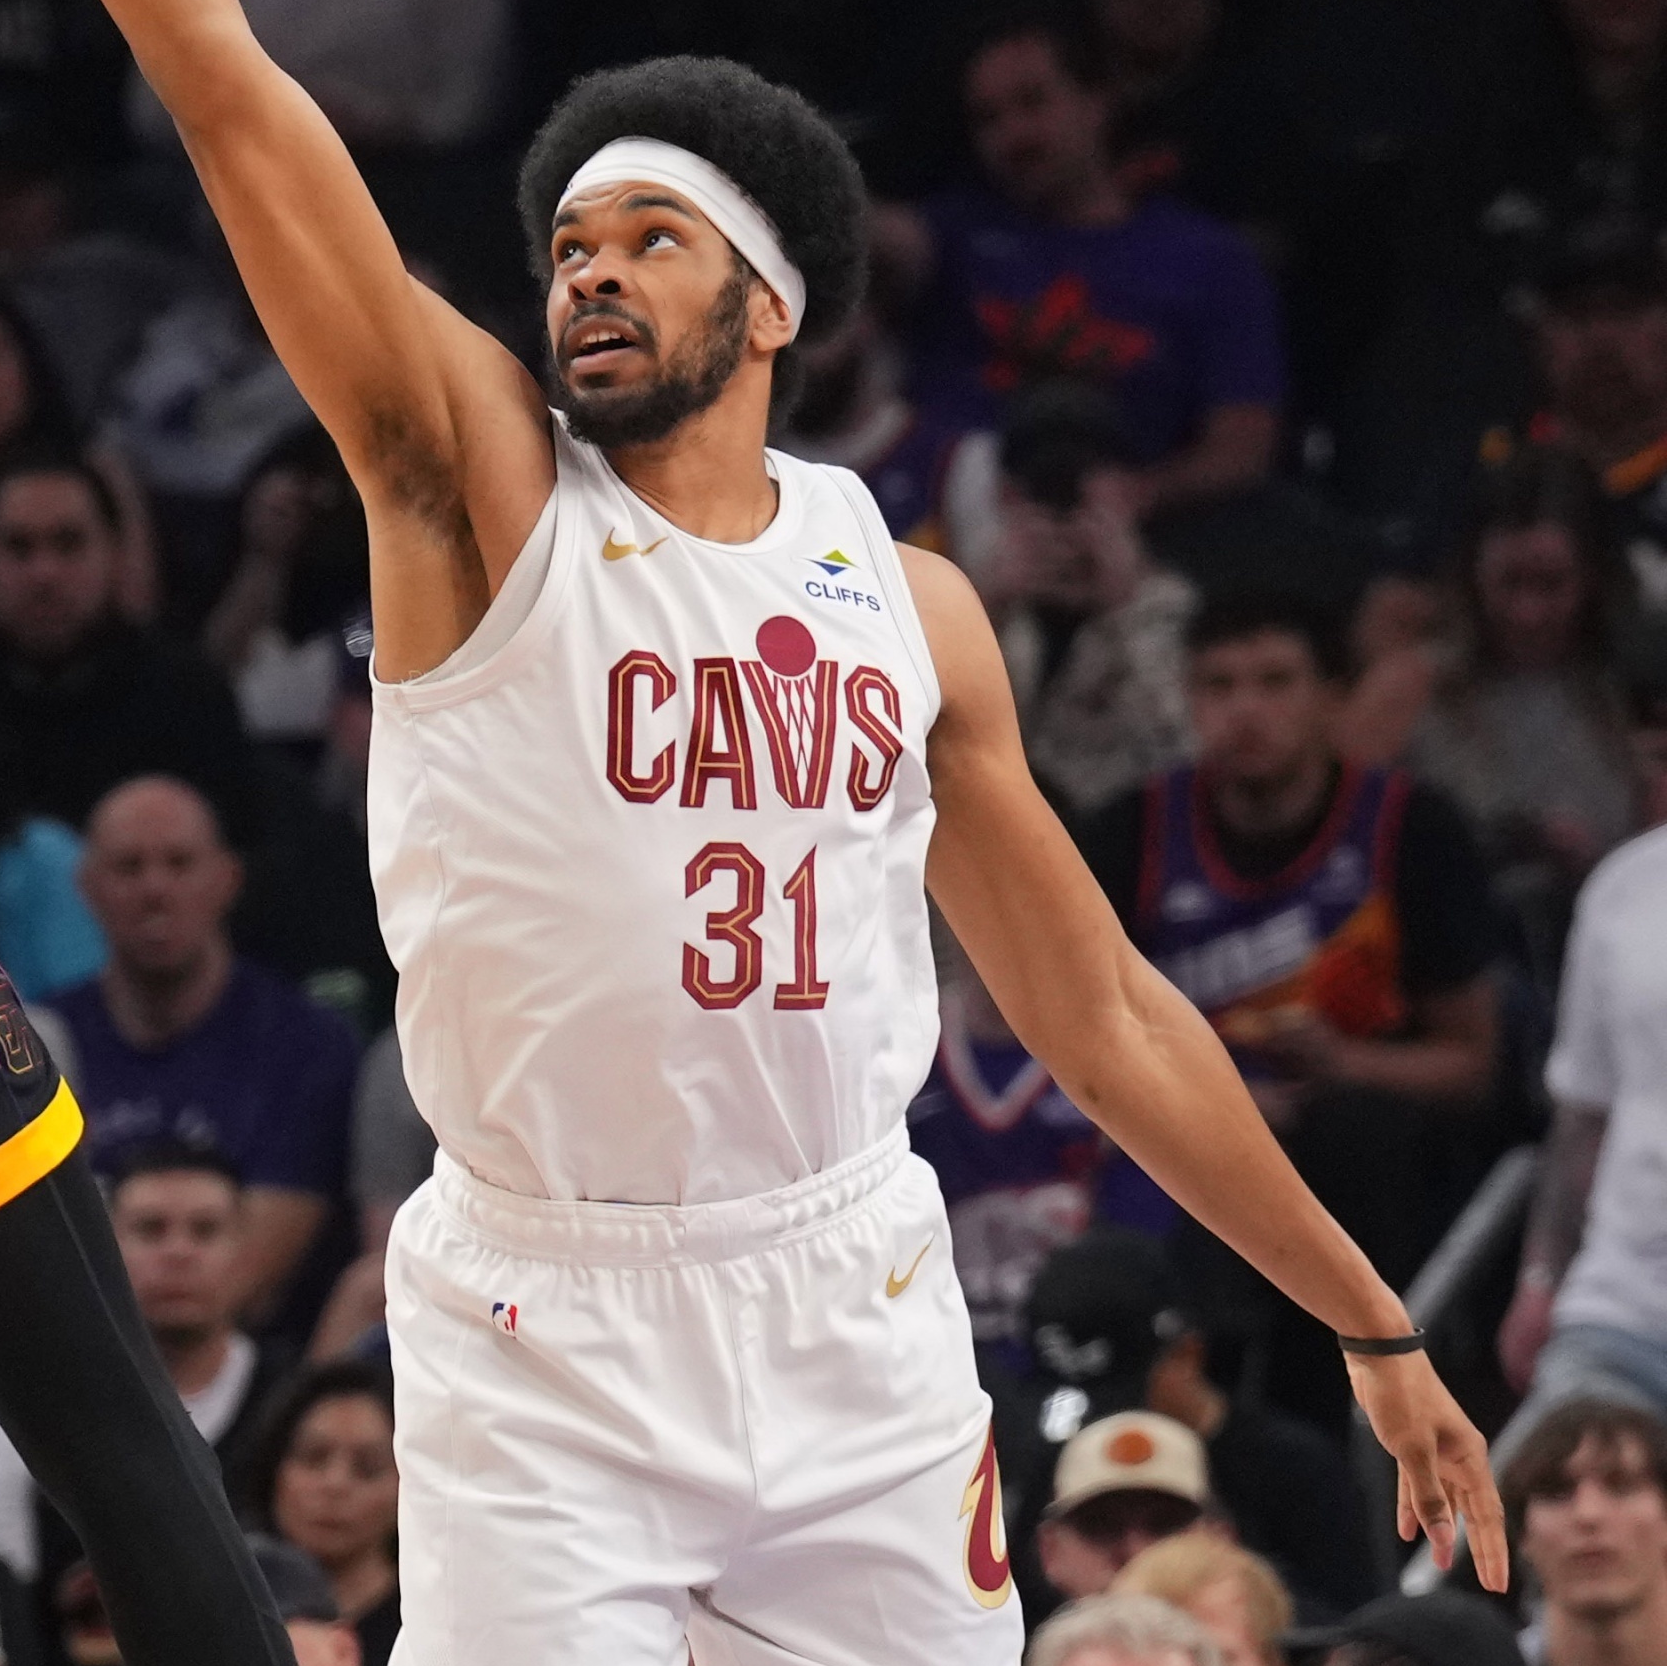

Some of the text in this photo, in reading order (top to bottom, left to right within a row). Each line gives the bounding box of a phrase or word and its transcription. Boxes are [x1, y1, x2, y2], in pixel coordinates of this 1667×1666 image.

[804, 579, 882, 614] CLIFFS
[606, 647, 904, 812] CAVS
[681, 841, 831, 1011] 31
